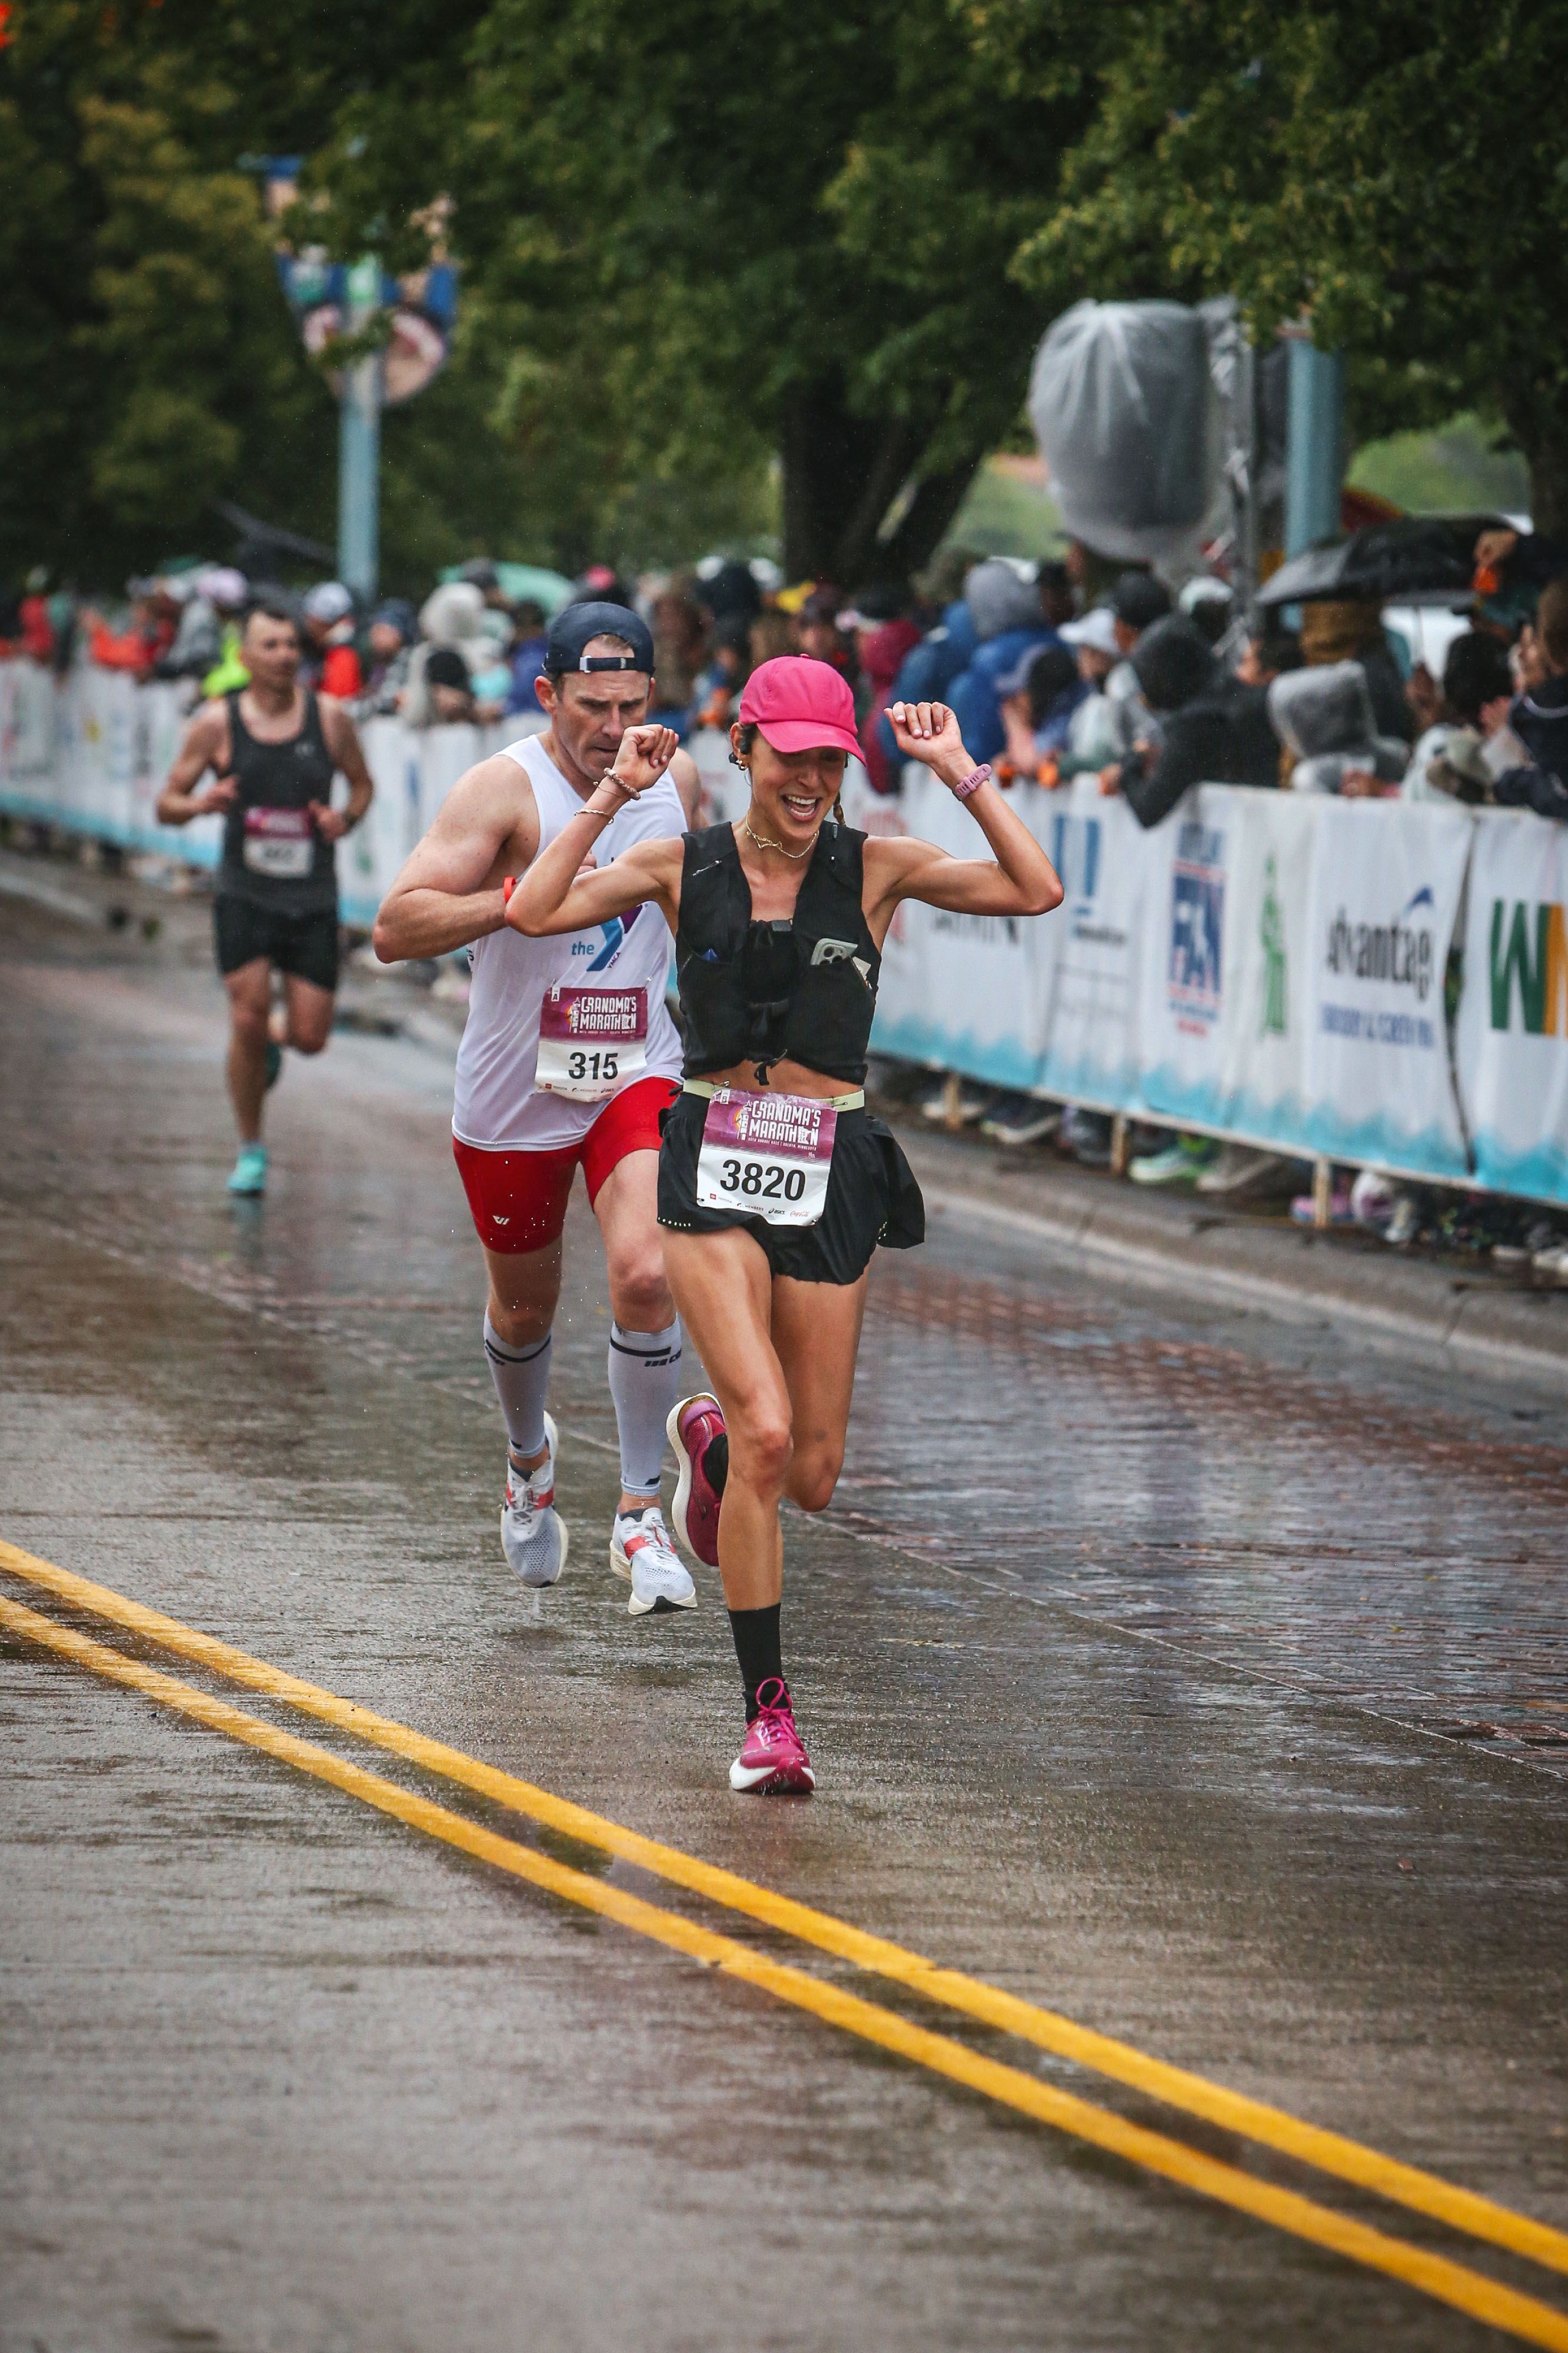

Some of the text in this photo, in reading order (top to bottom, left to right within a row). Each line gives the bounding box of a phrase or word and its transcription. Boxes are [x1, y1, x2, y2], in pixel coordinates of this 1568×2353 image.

[571, 941, 595, 955] the
[607, 952, 621, 969] YMCA
[581, 996, 637, 1013] GRANDMA'S
[568, 1052, 618, 1080] 315
[752, 1100, 822, 1127] GRANDMA'S
[720, 1159, 806, 1201] 3820
